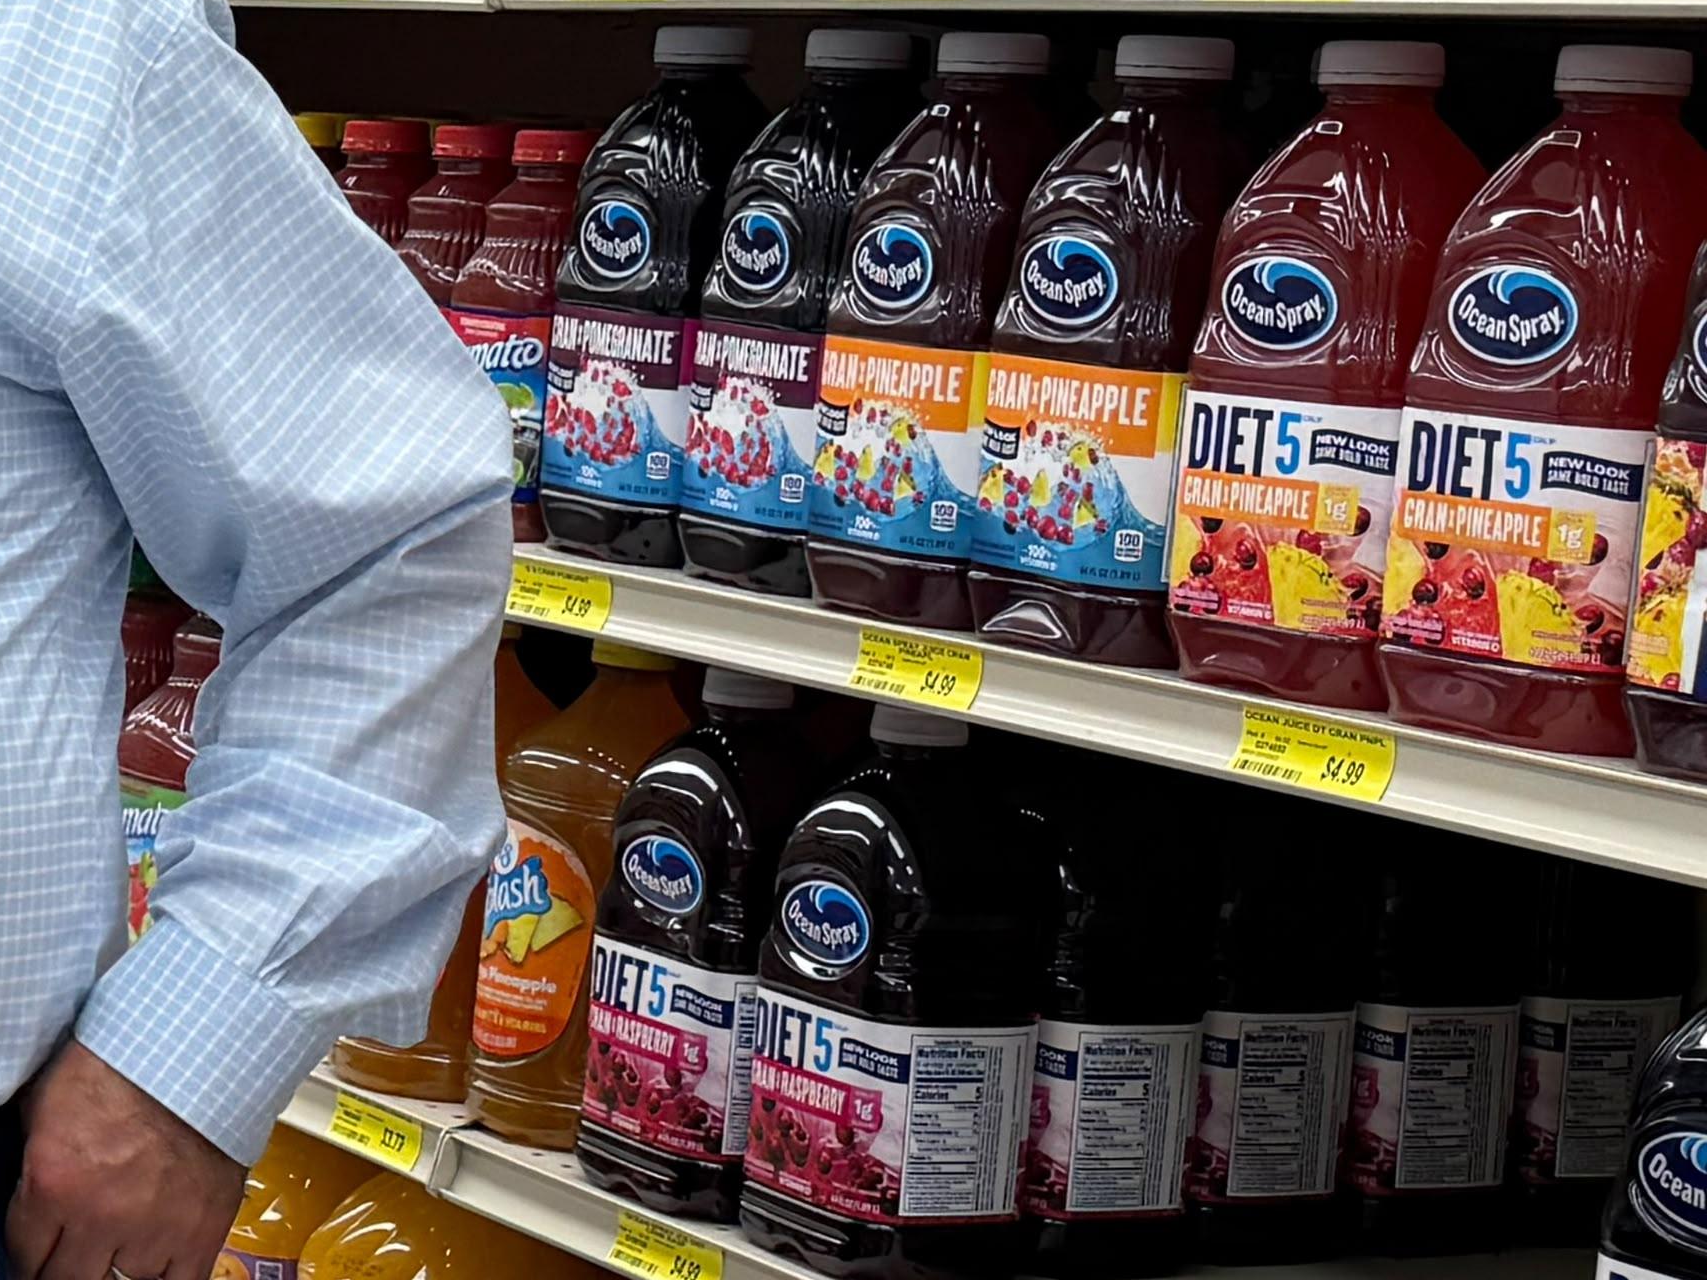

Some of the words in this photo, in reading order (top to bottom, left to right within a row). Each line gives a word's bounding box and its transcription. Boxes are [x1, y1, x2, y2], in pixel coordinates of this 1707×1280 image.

[726, 234, 752, 267] Ocean
[752, 241, 782, 275] Spray
[857, 253, 888, 288] Ocean
[888, 256, 923, 293] Spray
[1026, 268, 1064, 303] Ocean
[1065, 269, 1107, 311] Spray
[1230, 283, 1275, 330] Ocean
[1275, 290, 1324, 332] Spray
[1458, 293, 1507, 340] Ocean
[1509, 300, 1565, 346] Spray
[584, 322, 674, 365] POMEGRANATE
[721, 337, 810, 384] POMEGRANATE
[863, 356, 964, 404] PINEAPPLE
[987, 369, 1031, 407] CRAN
[1041, 374, 1148, 427] PINEAPPLE
[1189, 402, 1271, 474] DIET
[1276, 412, 1301, 475] 5
[1316, 432, 1343, 448] NEW
[1345, 438, 1390, 456] LOOK
[1412, 419, 1501, 498] DIET
[1505, 433, 1531, 500] 5
[1547, 457, 1574, 472] NEW
[1576, 462, 1630, 480] LOOK
[1185, 473, 1225, 508] CRAN
[1231, 480, 1312, 519] PINEAPPLE
[1404, 496, 1446, 534] CRAN
[1456, 506, 1542, 550] PINEAPPLE
[862, 632, 890, 647] OCEAN
[1244, 708, 1280, 726] OCEAN
[1282, 714, 1311, 731] JUICE
[1328, 724, 1357, 742] CRAN
[1320, 755, 1366, 786] $4.99
[660, 875, 693, 899] Spray
[789, 899, 822, 942] Ocean
[822, 915, 859, 950] Spray
[647, 964, 667, 1017] 5
[616, 1017, 675, 1057] RASPBERRY
[754, 995, 811, 1062] DIET
[813, 1020, 834, 1072] 5
[870, 1049, 900, 1067] LOOK
[781, 1072, 845, 1116] RASPBERRY
[914, 1086, 950, 1101] Calories
[1648, 1151, 1706, 1210] Ocean
